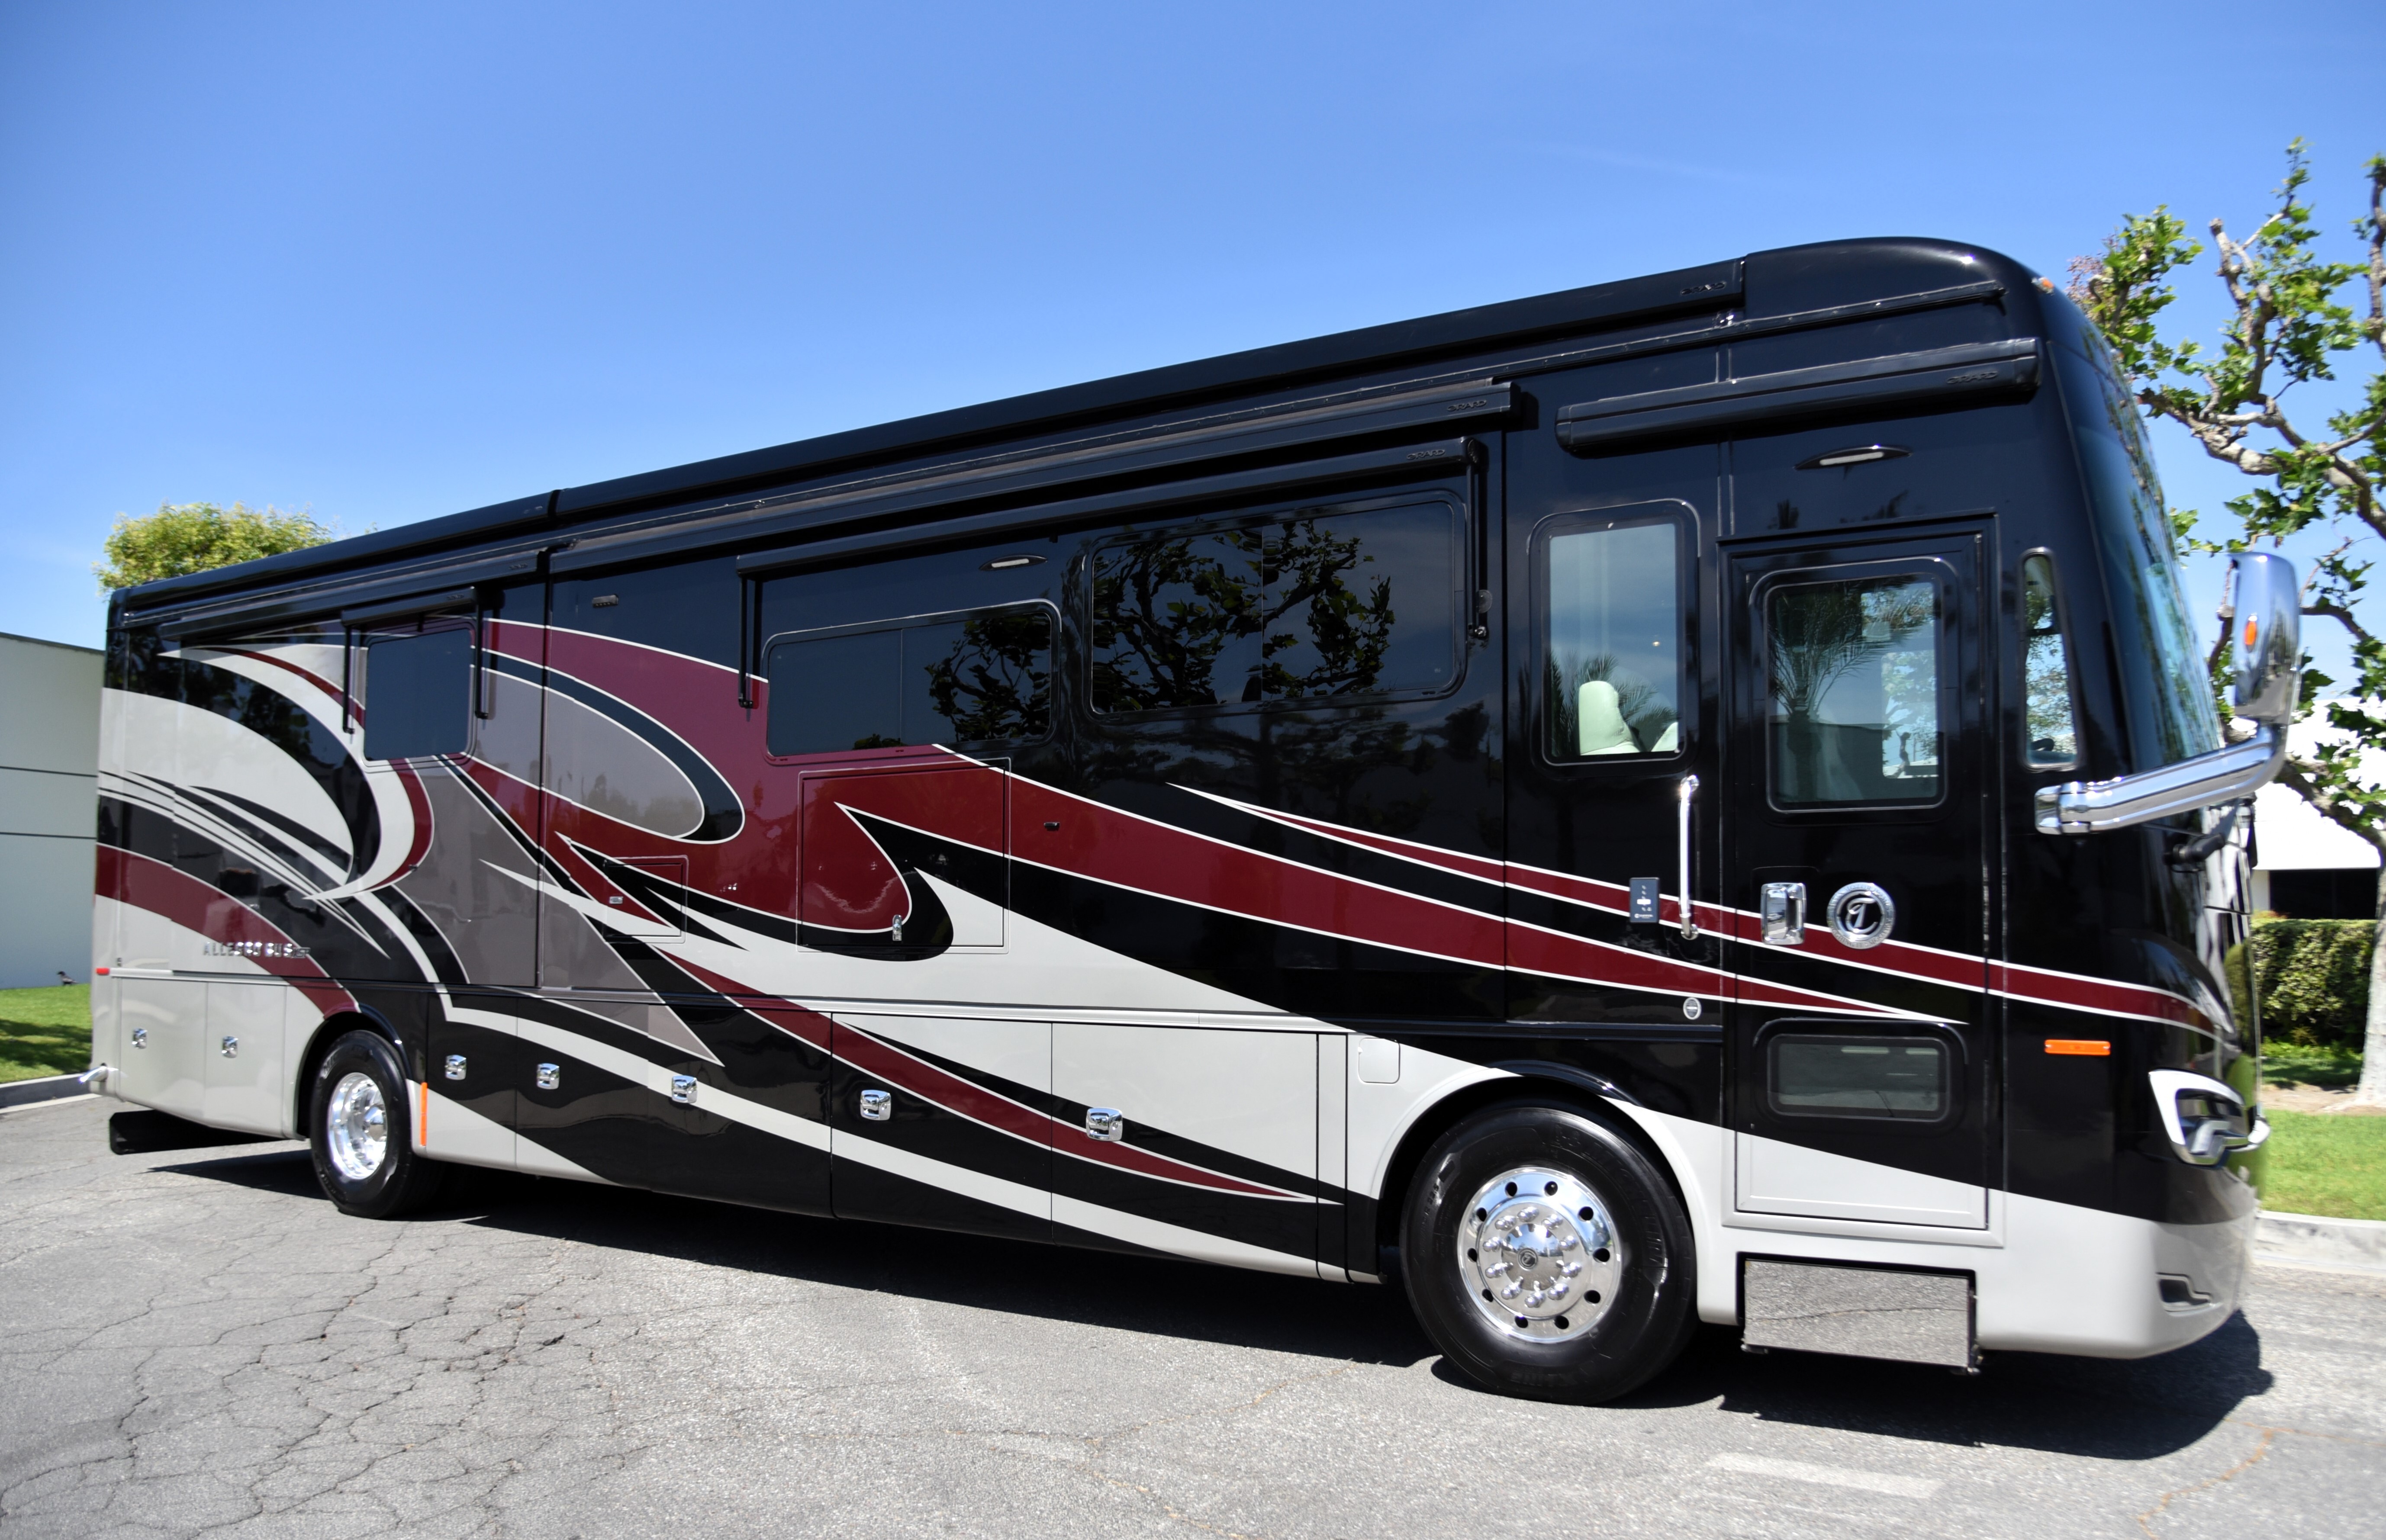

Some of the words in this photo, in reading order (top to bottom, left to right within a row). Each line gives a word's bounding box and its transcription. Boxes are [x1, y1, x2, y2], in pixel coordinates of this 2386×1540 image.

[1447, 400, 1487, 411] GIRARD
[1407, 450, 1445, 460] GIRARD
[204, 941, 262, 957] ALLEGRO
[265, 942, 293, 958] BUS
